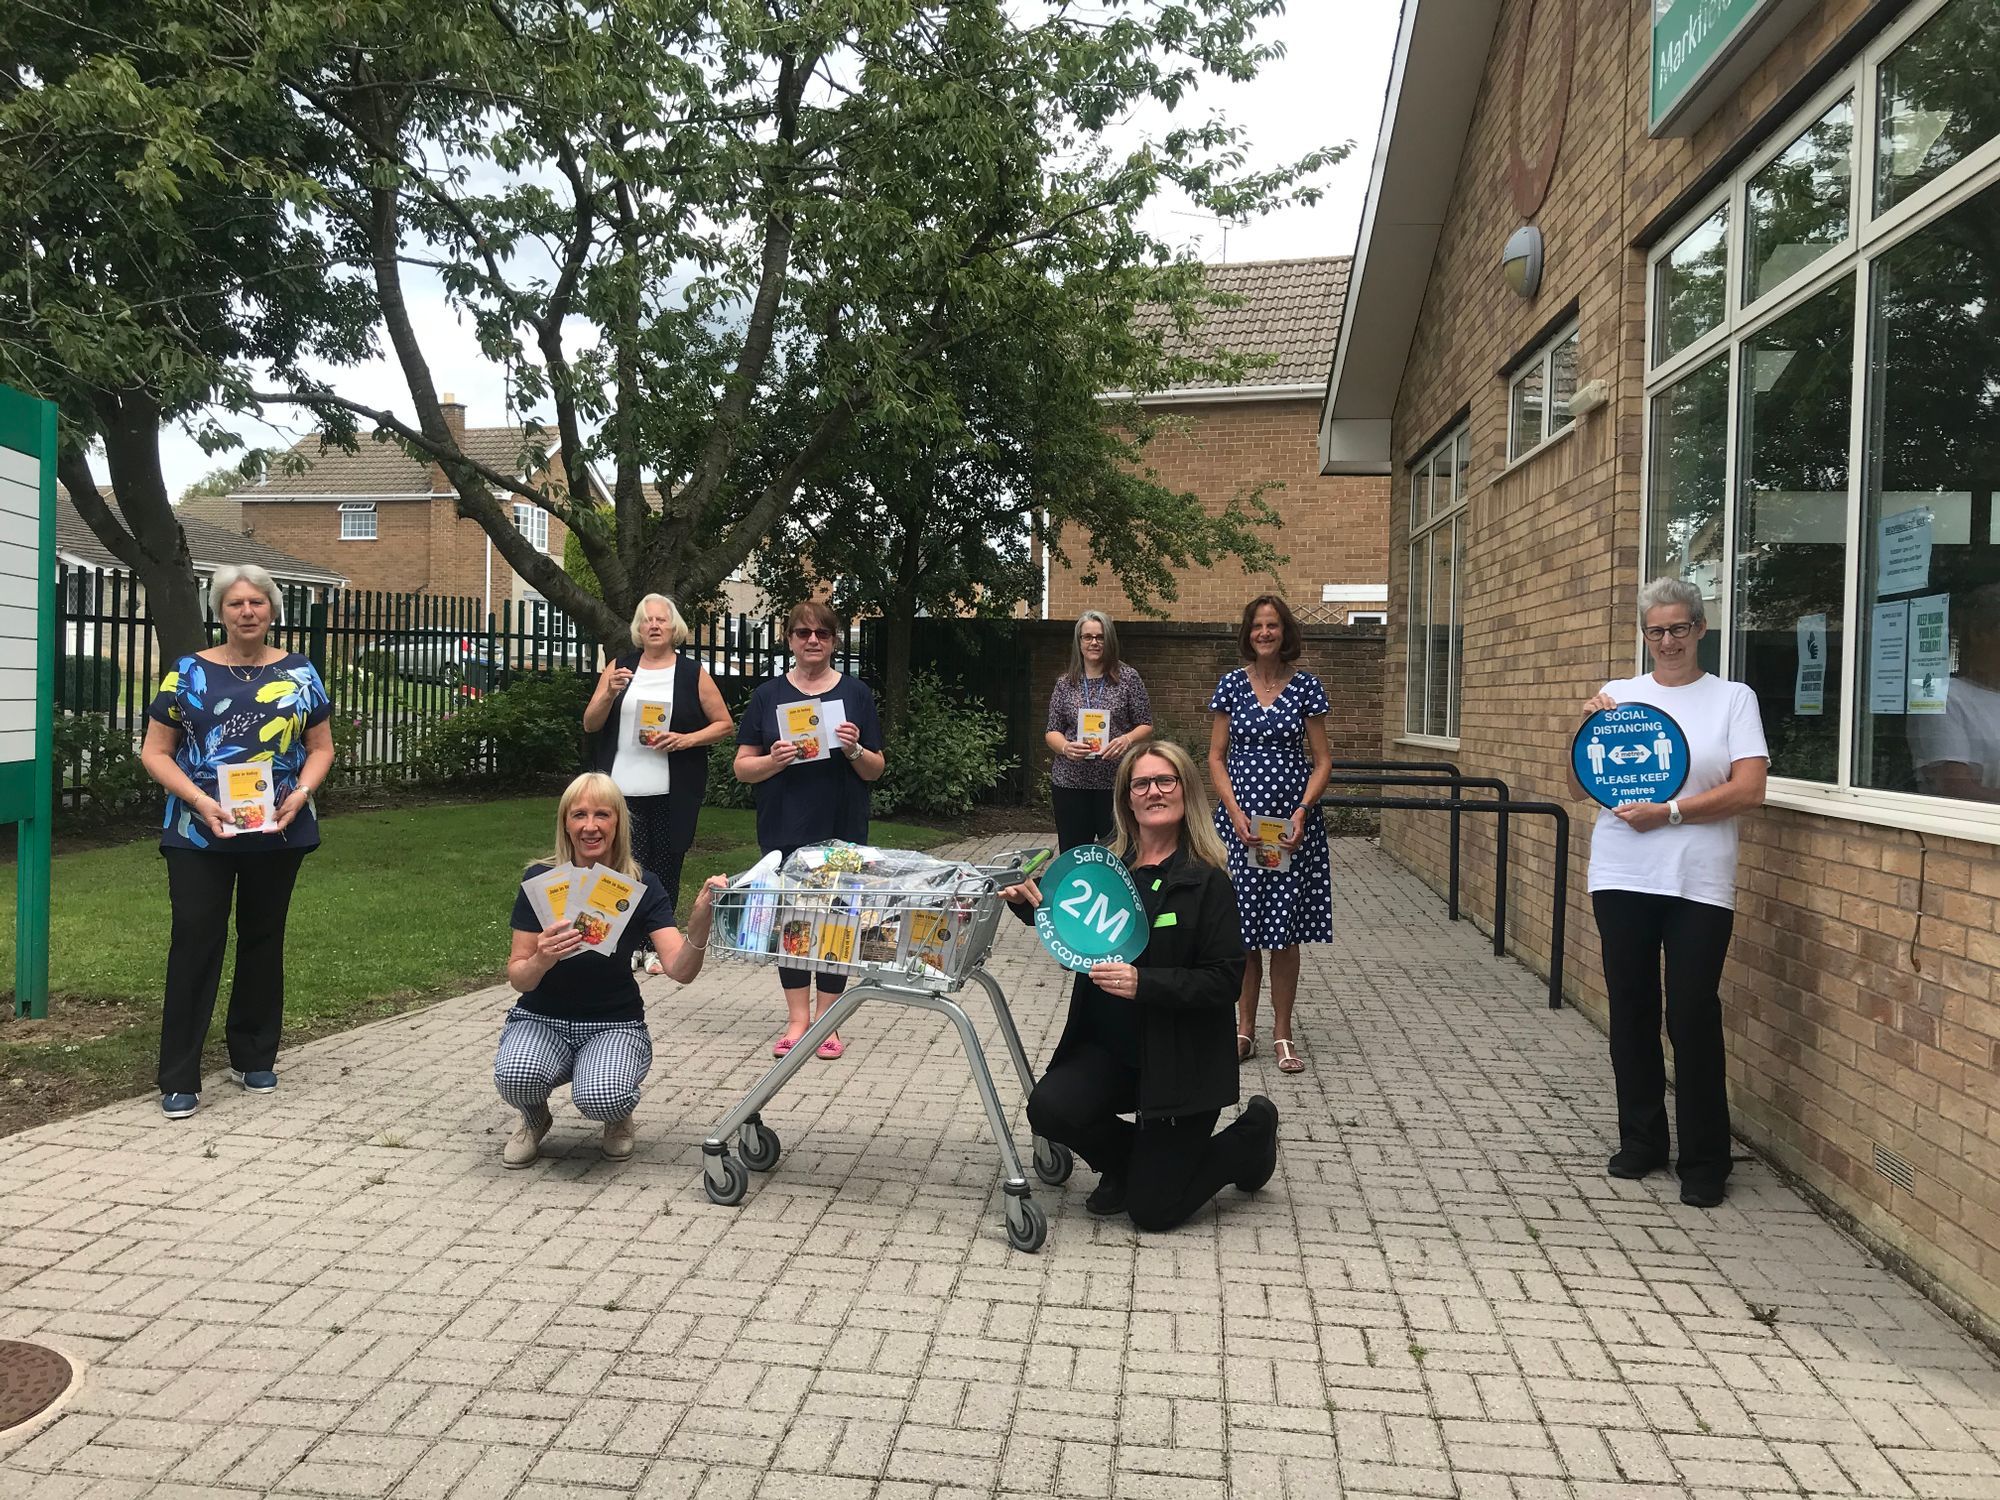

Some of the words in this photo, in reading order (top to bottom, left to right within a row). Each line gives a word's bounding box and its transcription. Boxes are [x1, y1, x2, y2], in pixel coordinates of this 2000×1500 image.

[1659, 0, 1732, 91] Markfiel
[1605, 710, 1648, 721] SOCIAL
[1593, 722, 1663, 735] DISTANCING
[1621, 750, 1645, 758] metres
[1596, 774, 1638, 785] PLEASE
[1640, 772, 1670, 782] KEEP
[1611, 787, 1618, 796] 2
[1621, 786, 1655, 796] metres
[1073, 847, 1103, 864] Safe
[1106, 852, 1142, 912] Distance
[1059, 879, 1130, 943] 2M
[1036, 907, 1054, 939] let's
